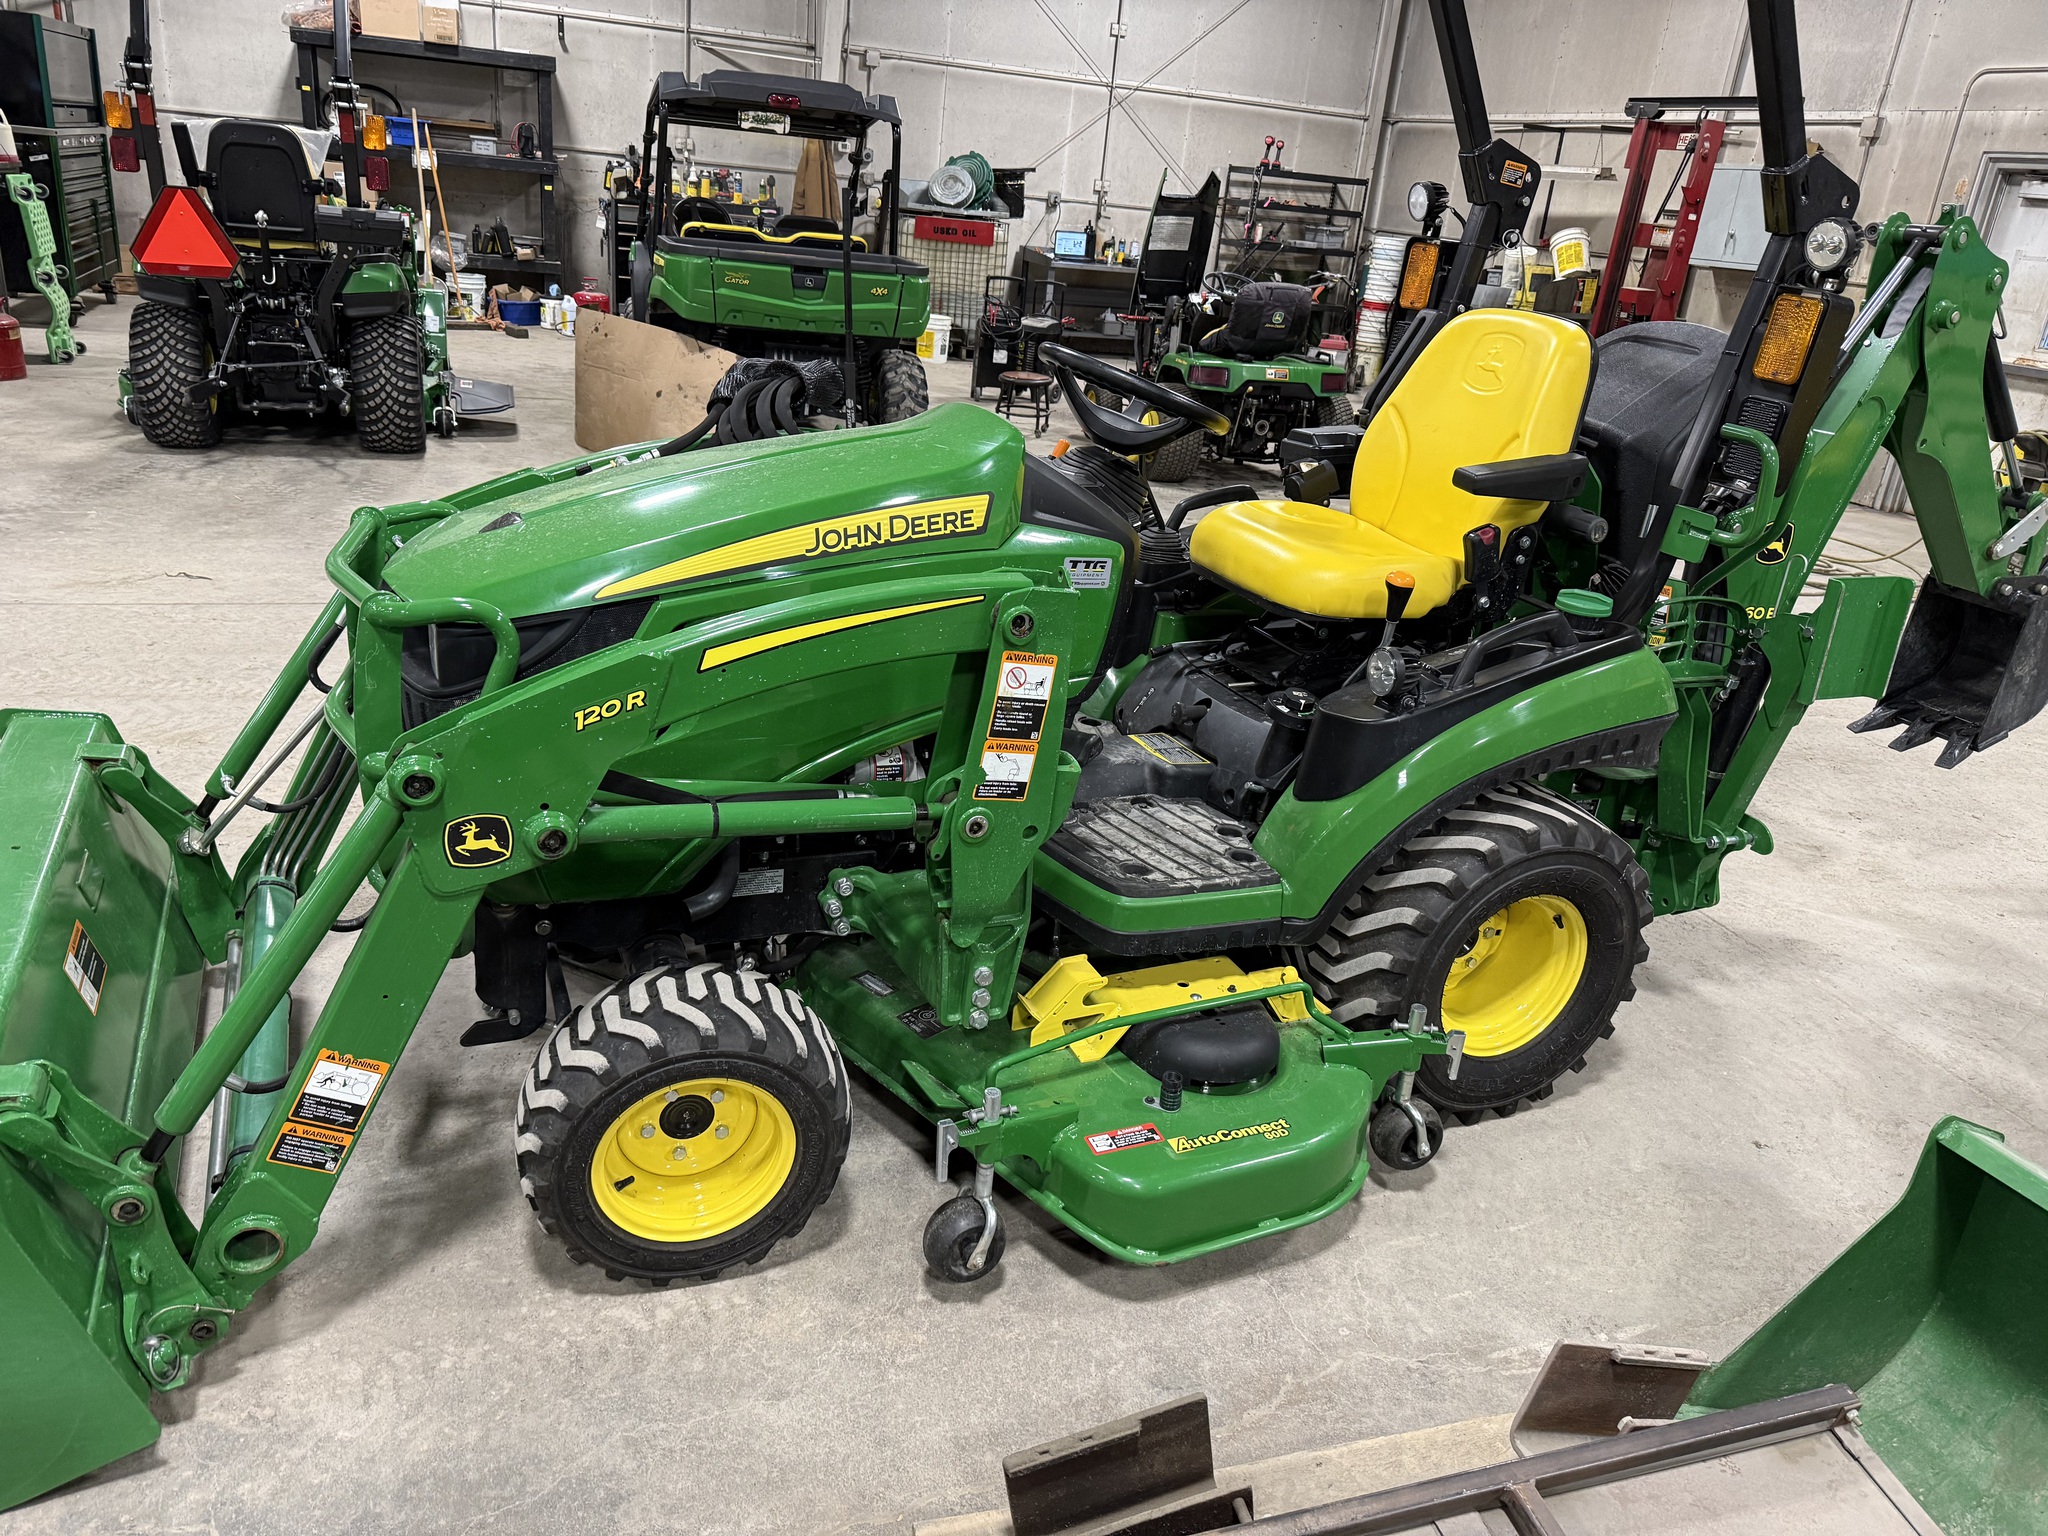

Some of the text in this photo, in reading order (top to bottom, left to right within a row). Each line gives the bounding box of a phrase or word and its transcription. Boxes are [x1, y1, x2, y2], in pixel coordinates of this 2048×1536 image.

[933, 226, 976, 238] USED OIL
[724, 276, 750, 286] GATOR
[805, 509, 974, 553] JOHN DEERE
[1069, 560, 1108, 572] TTG
[1014, 653, 1054, 664] WARNING
[574, 690, 646, 732] 120 R
[996, 743, 1034, 752] WARNING
[338, 1055, 380, 1071] WARNING
[302, 1129, 344, 1143] WARNING
[1177, 1118, 1290, 1152] AutoConnect
[1264, 1128, 1290, 1140] 60D
